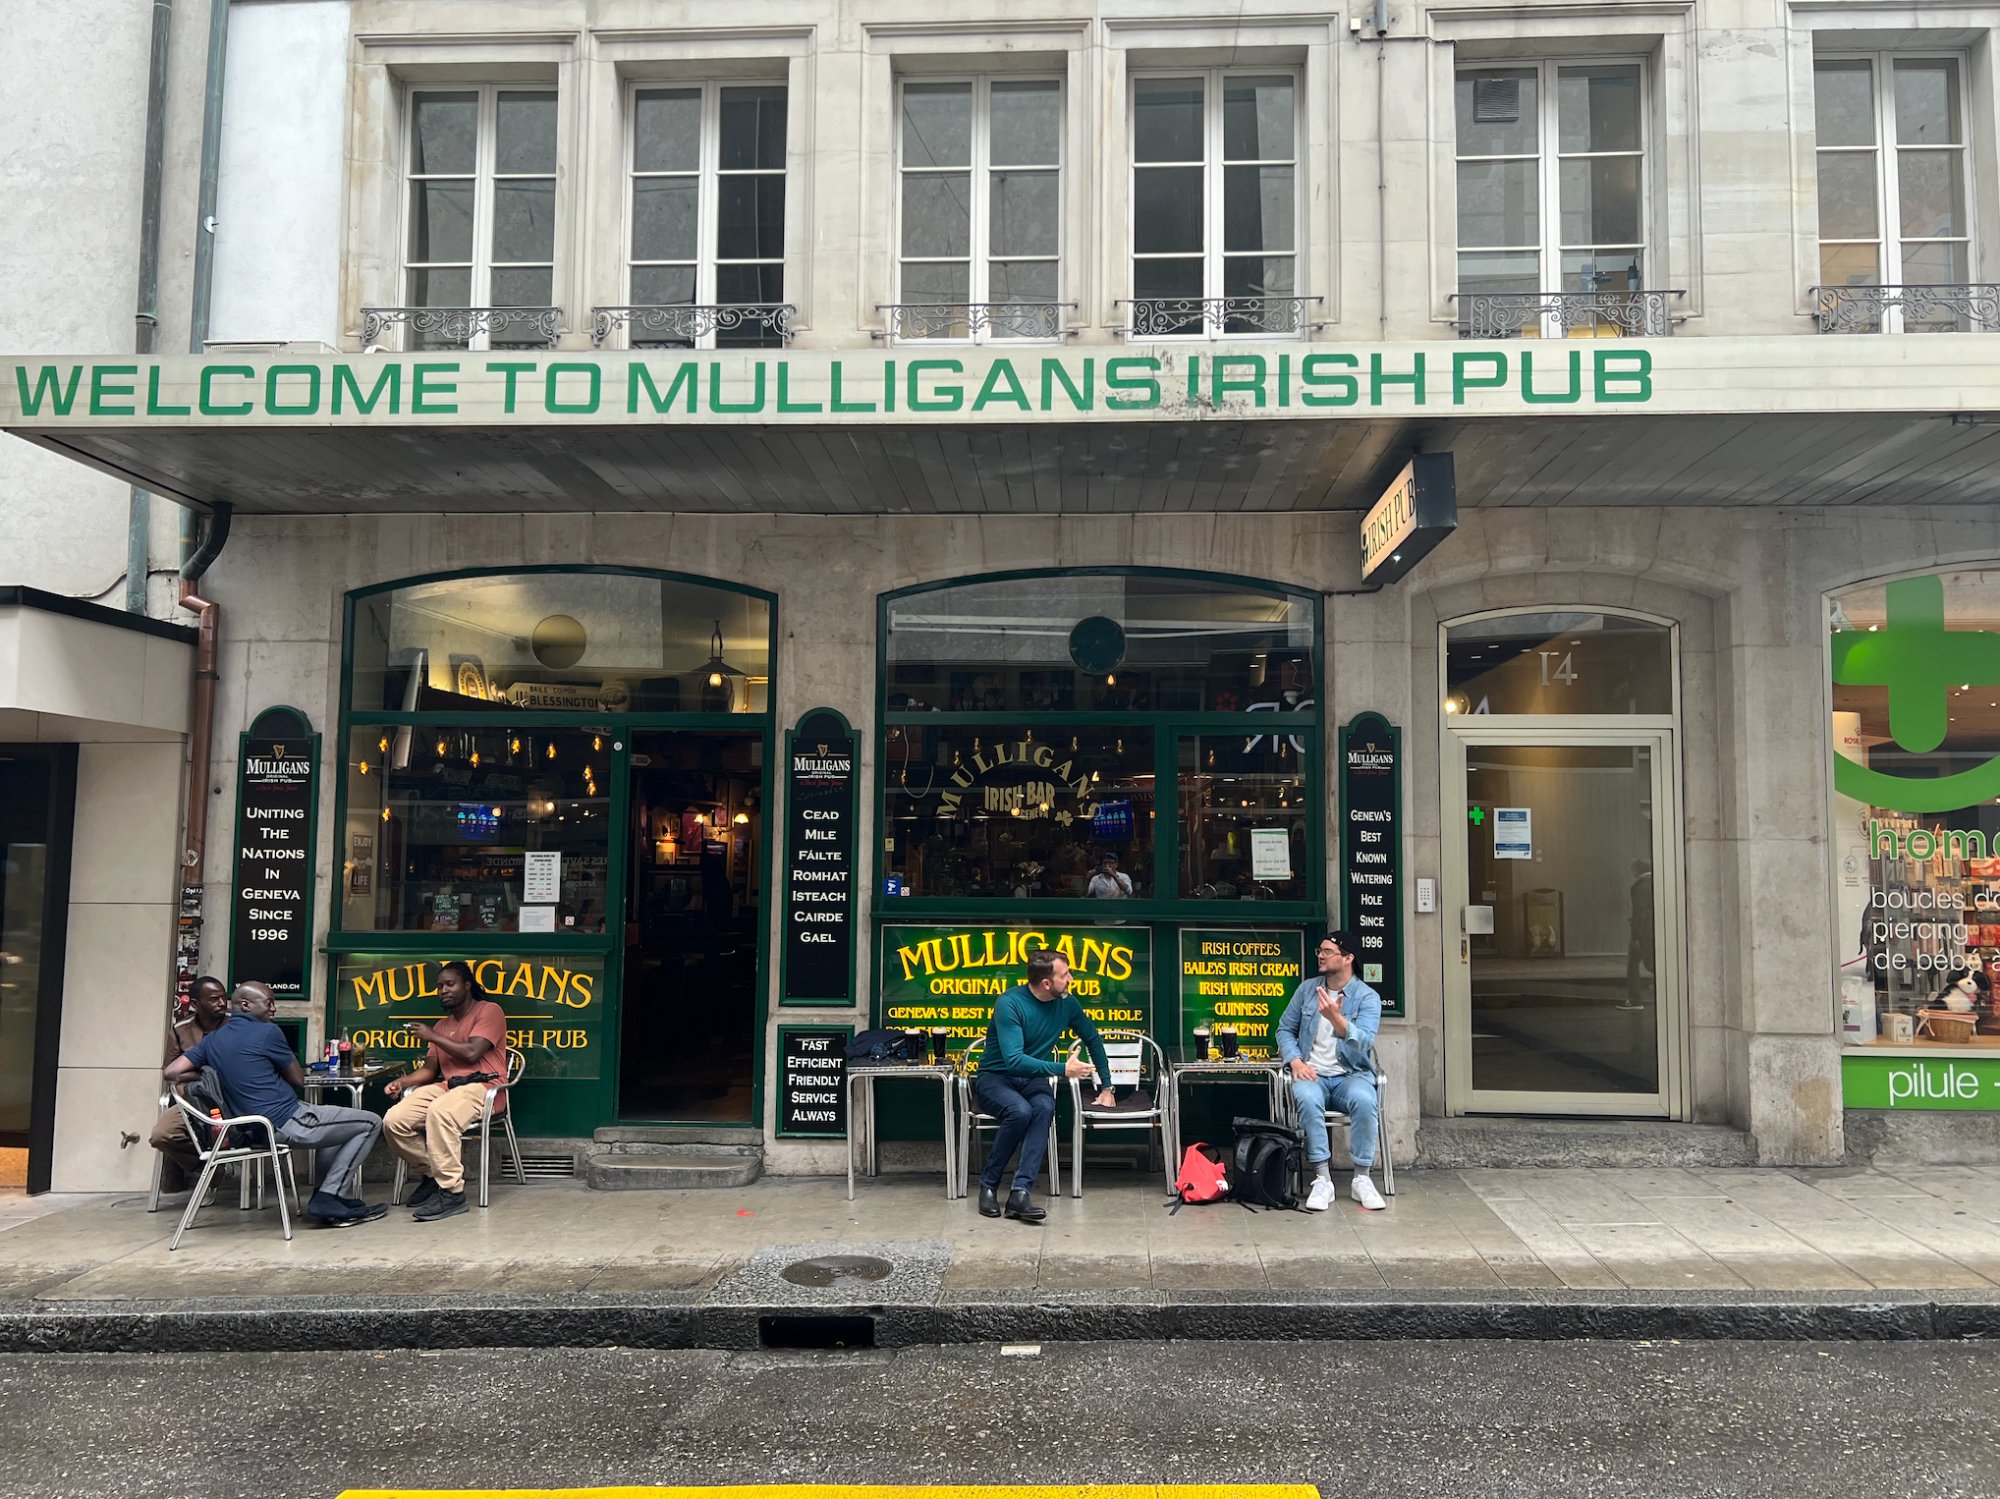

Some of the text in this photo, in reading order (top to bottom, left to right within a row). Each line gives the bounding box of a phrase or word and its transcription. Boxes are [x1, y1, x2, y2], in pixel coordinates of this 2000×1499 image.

[16, 350, 1652, 416] WELCOME TO MULLIGANS IRISH PUB
[1367, 478, 1416, 560] IRISH PUB
[1539, 651, 1578, 686] 14
[794, 757, 851, 771] MULLIGANS
[1347, 752, 1394, 764] MULLIGANS
[246, 758, 310, 775] MULLIGANS
[936, 741, 1102, 820] MULLIGANS
[984, 781, 1056, 812] IRISH BAR
[246, 807, 305, 819] UNITING
[803, 809, 840, 820] CEAD
[1350, 809, 1392, 822] GENEVA'S
[260, 827, 290, 839] THE
[805, 829, 837, 840] MILE
[1360, 830, 1382, 843] BEST
[242, 847, 305, 860] NATIONS
[798, 850, 842, 860] FÁILTE
[1356, 852, 1387, 864] KNOWN
[265, 868, 280, 880] IN
[793, 869, 848, 881] ROMHAT
[1350, 872, 1393, 885] WATERING
[241, 888, 301, 900] GENEVA
[792, 890, 846, 902] ISTEACH
[1360, 893, 1383, 906] HOLE
[1871, 887, 1965, 909] boucles
[249, 908, 293, 921] SINCE
[794, 911, 844, 922] CAIRDE
[1359, 914, 1385, 927] SINCE
[250, 928, 289, 942] 1996
[800, 932, 837, 943] GAEL
[1873, 917, 1969, 945] piercing
[1202, 942, 1281, 956] IRISH COFFEES
[1361, 936, 1383, 949] 1996
[1874, 948, 1907, 970] de
[1916, 948, 1981, 971] bébé
[1184, 961, 1299, 977] BAILEYS IRISH CREAM
[352, 959, 594, 1011] MULGANS
[1068, 979, 1101, 996] PUB
[1199, 981, 1285, 996] IRISH WHISKEYS
[888, 1007, 949, 1019] GENEVA'S
[952, 1007, 984, 1019] BEST
[1108, 1009, 1143, 1021] HOLE
[1214, 1003, 1269, 1016] GUINNESS
[946, 1026, 988, 1038] ENGLIS
[543, 1030, 588, 1048] PUB
[801, 1040, 830, 1051] FAST
[787, 1056, 843, 1069] EFFICIENT
[788, 1074, 840, 1086] FRIENDLY
[1888, 1063, 1979, 1106] pilule
[791, 1091, 838, 1104] SERVICE
[791, 1109, 836, 1122] ALWAYS
